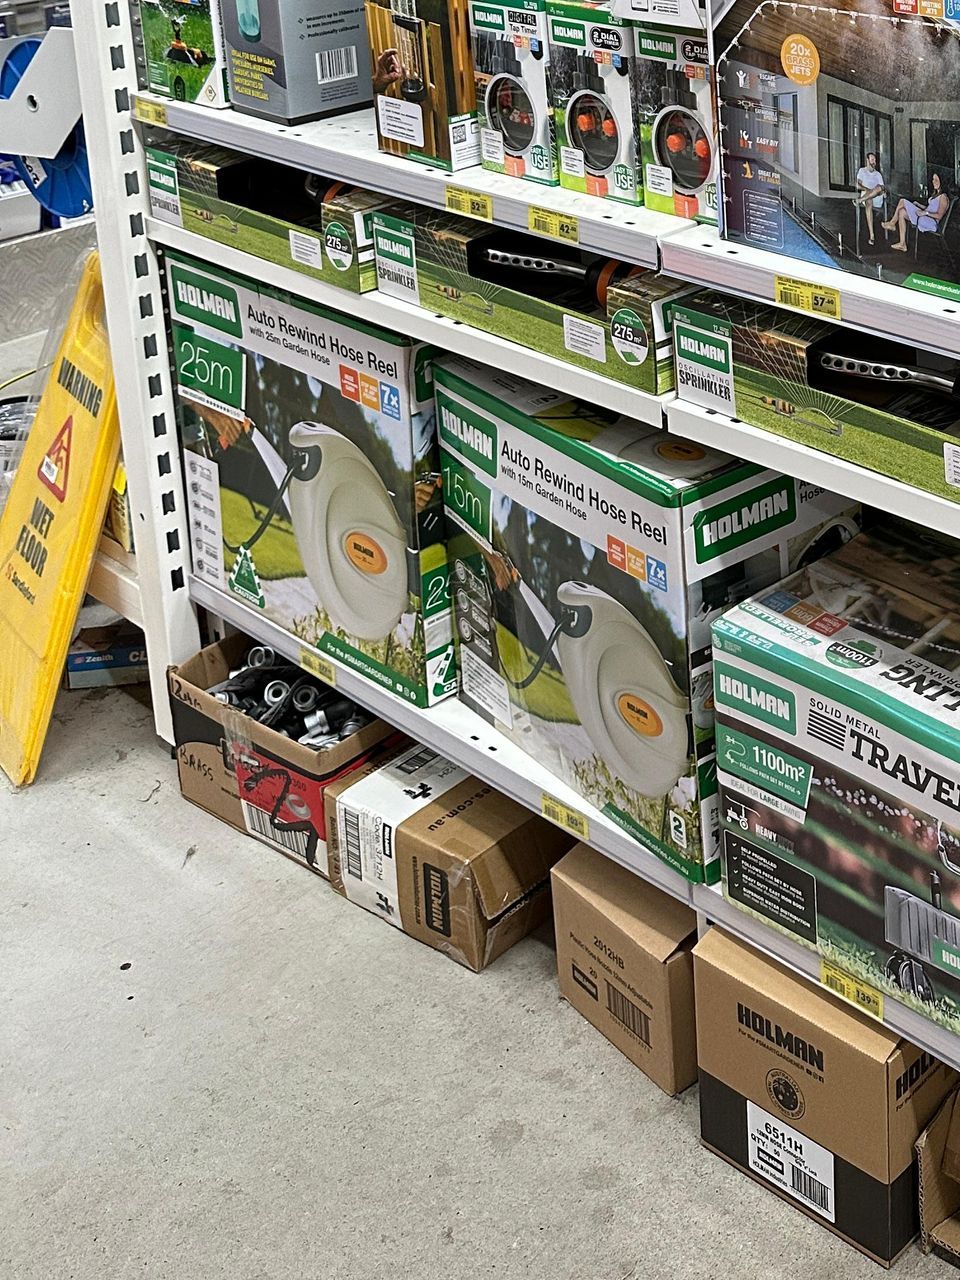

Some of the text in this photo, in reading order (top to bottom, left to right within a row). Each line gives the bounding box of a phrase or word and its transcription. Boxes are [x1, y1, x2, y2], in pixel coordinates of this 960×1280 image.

[508, 12, 537, 26] DIGITAL
[176, 281, 237, 322] HOLMAN
[248, 304, 398, 379] Auto Rewind Hose Reel
[56, 357, 103, 419] WARNING
[179, 341, 234, 395] 25m
[440, 404, 494, 460] HOLMAN
[501, 441, 668, 545] Auto Rewind Hose Reel
[702, 489, 789, 547] HOLMAN
[85, 654, 113, 663] Zenith
[342, 648, 393, 687] #SMARTGARDENER
[719, 674, 790, 721] HOLMAN
[809, 698, 881, 739] SOLID METAL
[592, 935, 625, 970] 2012HB
[736, 1002, 824, 1071] HOLMAN
[764, 1122, 803, 1156] 6511H
